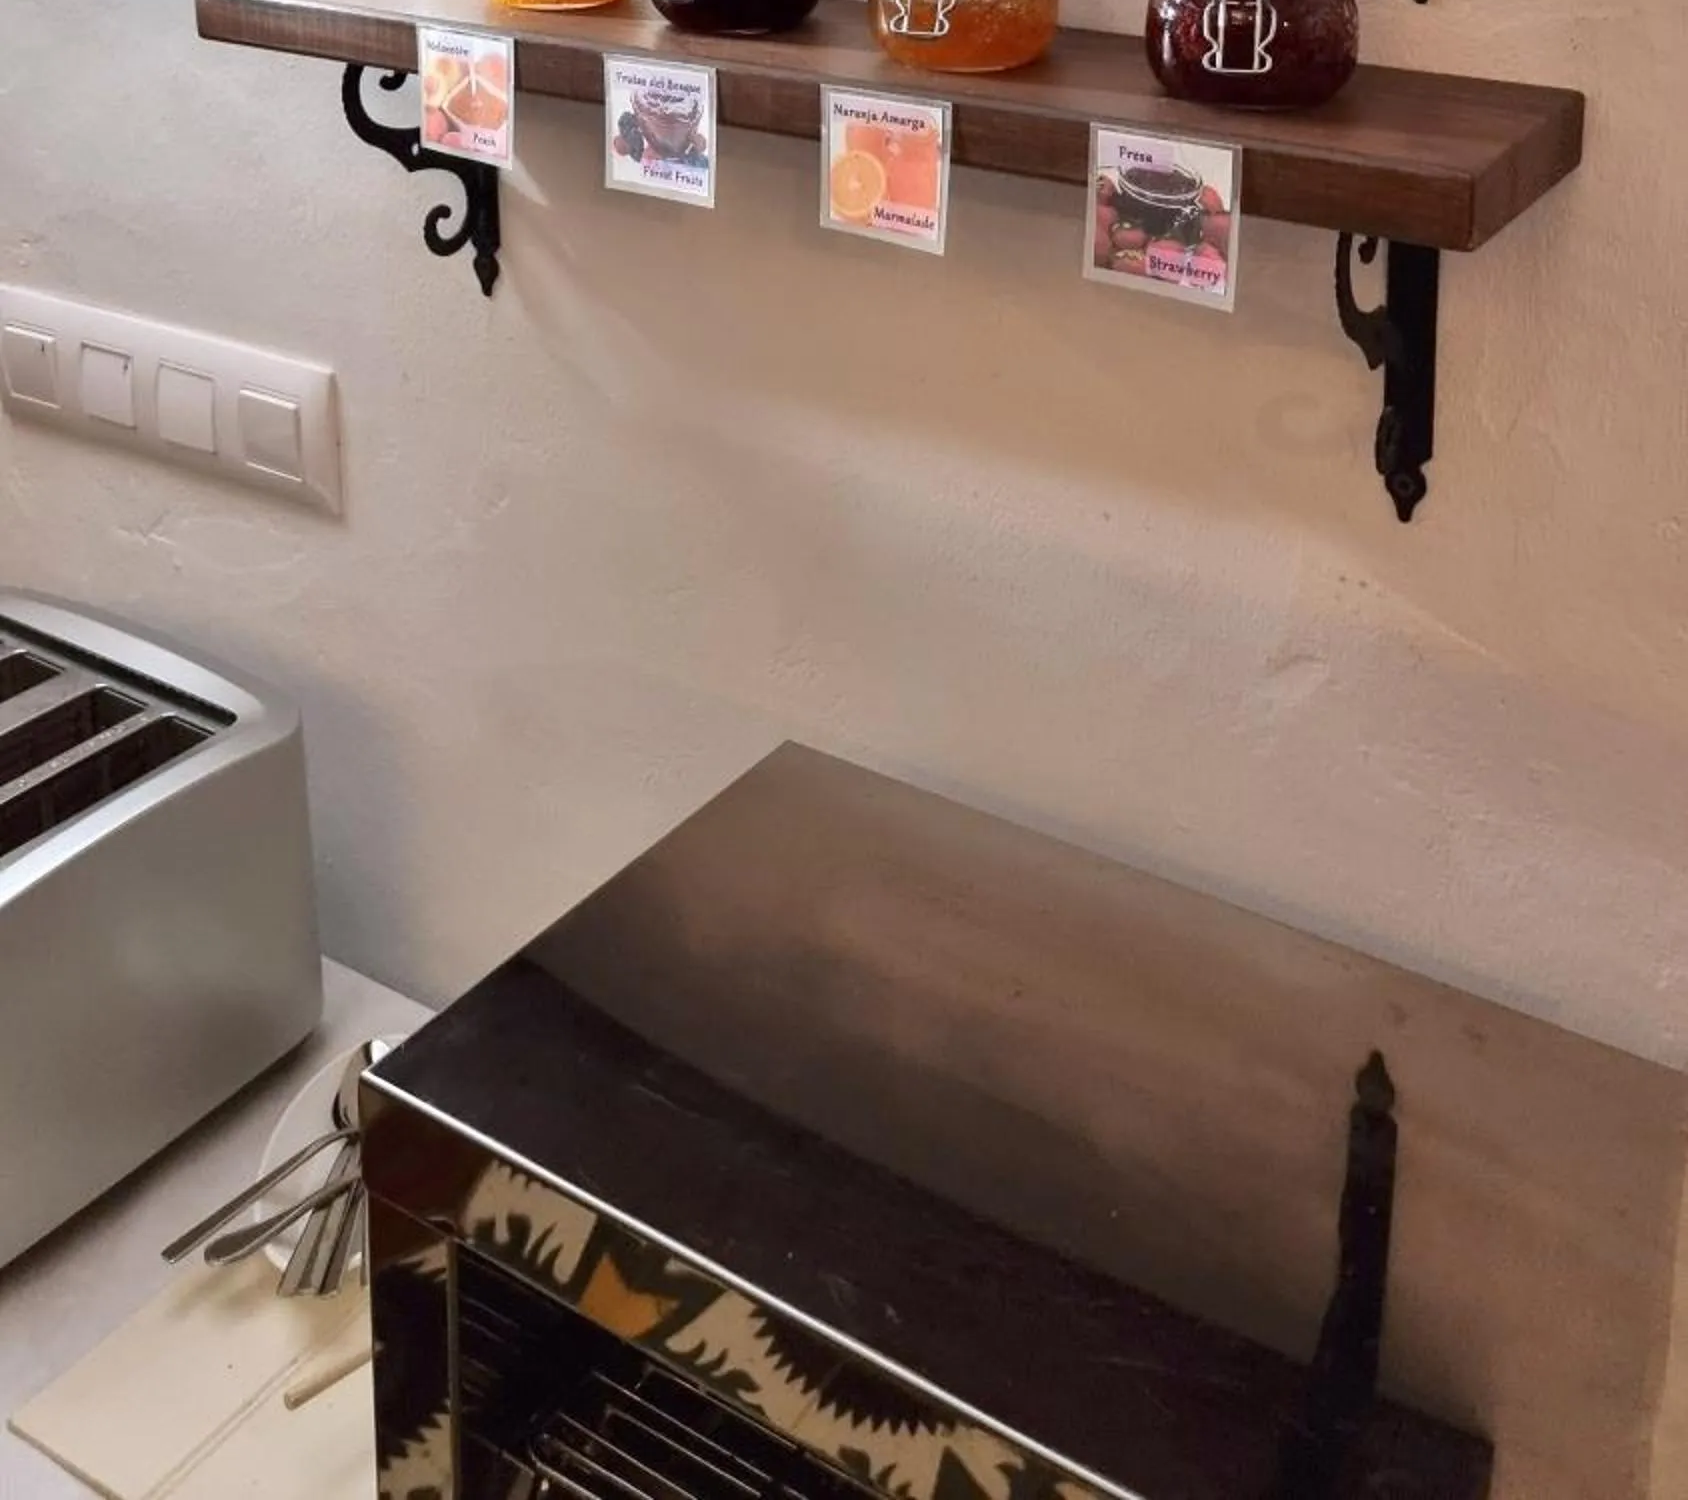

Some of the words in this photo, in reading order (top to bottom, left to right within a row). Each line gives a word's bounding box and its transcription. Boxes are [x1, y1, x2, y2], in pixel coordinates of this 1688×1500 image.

[833, 103, 878, 124] Naranja
[881, 110, 925, 132] Amarga
[1119, 145, 1153, 164] Fresa
[643, 165, 673, 181] Forest
[675, 171, 703, 188] Fruits
[873, 205, 936, 230] Marmalade
[1149, 255, 1221, 286] Strawberry
